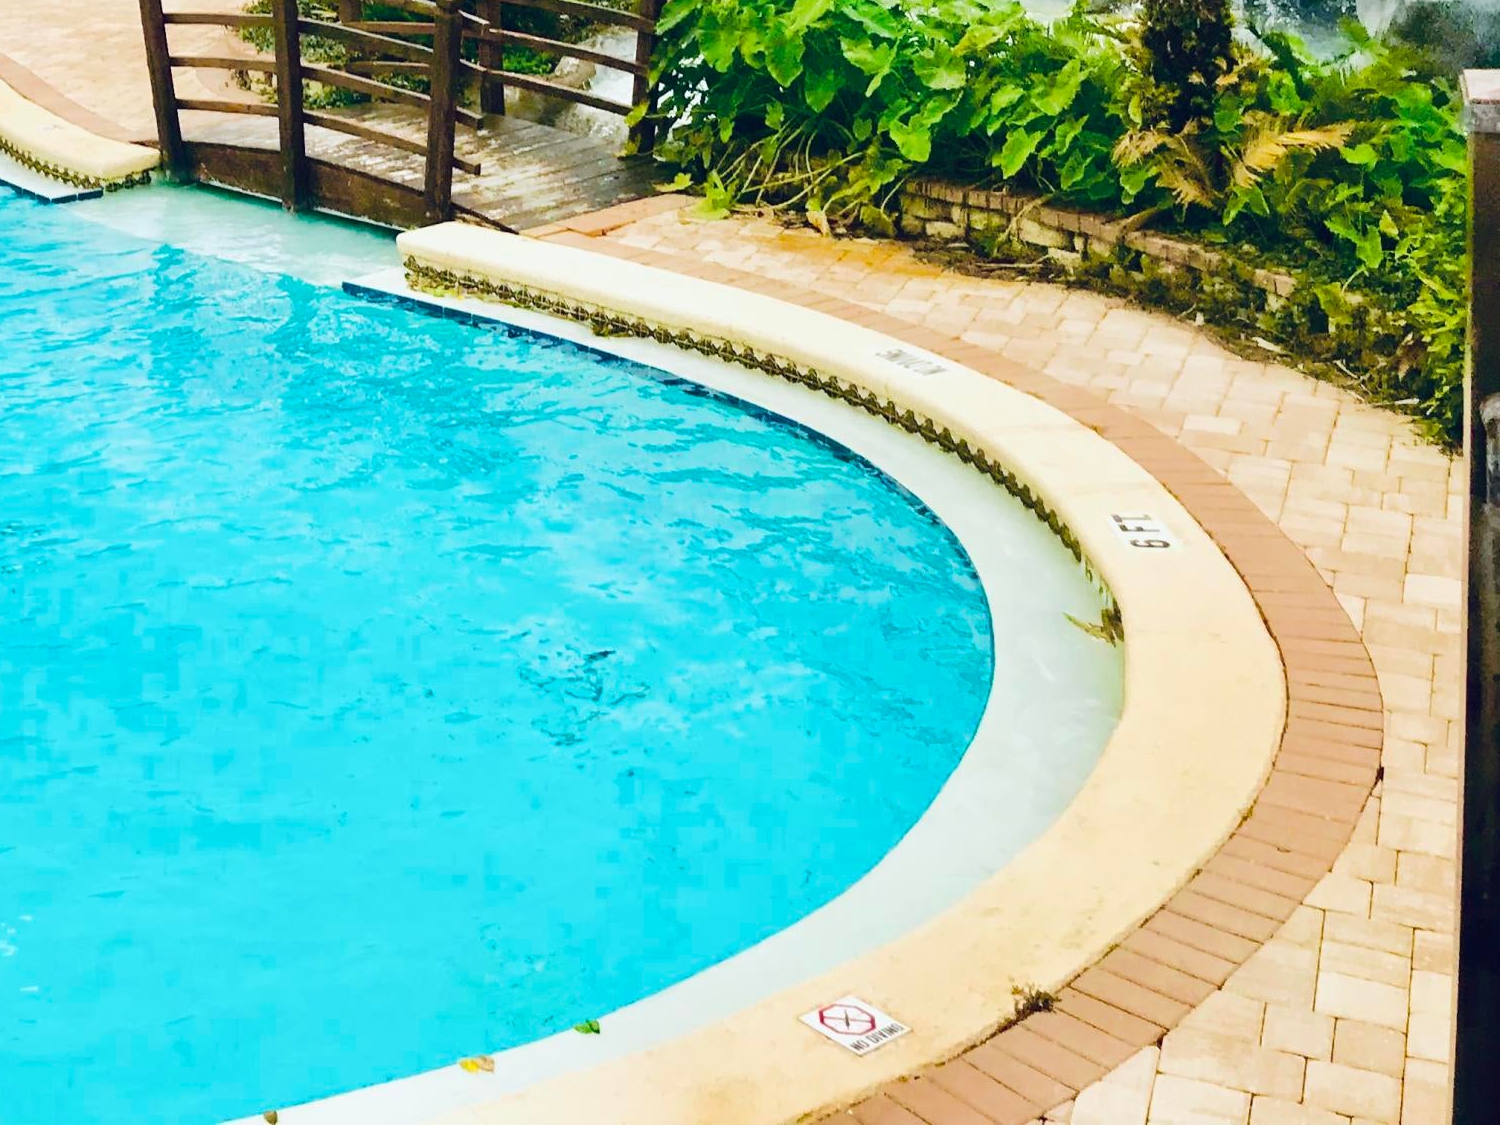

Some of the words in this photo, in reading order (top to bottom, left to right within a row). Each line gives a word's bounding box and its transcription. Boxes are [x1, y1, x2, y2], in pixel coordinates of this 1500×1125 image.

[1110, 514, 1160, 532] FT
[1129, 539, 1171, 548] 6
[849, 1039, 870, 1051] NO
[865, 1023, 904, 1044] DIVING
